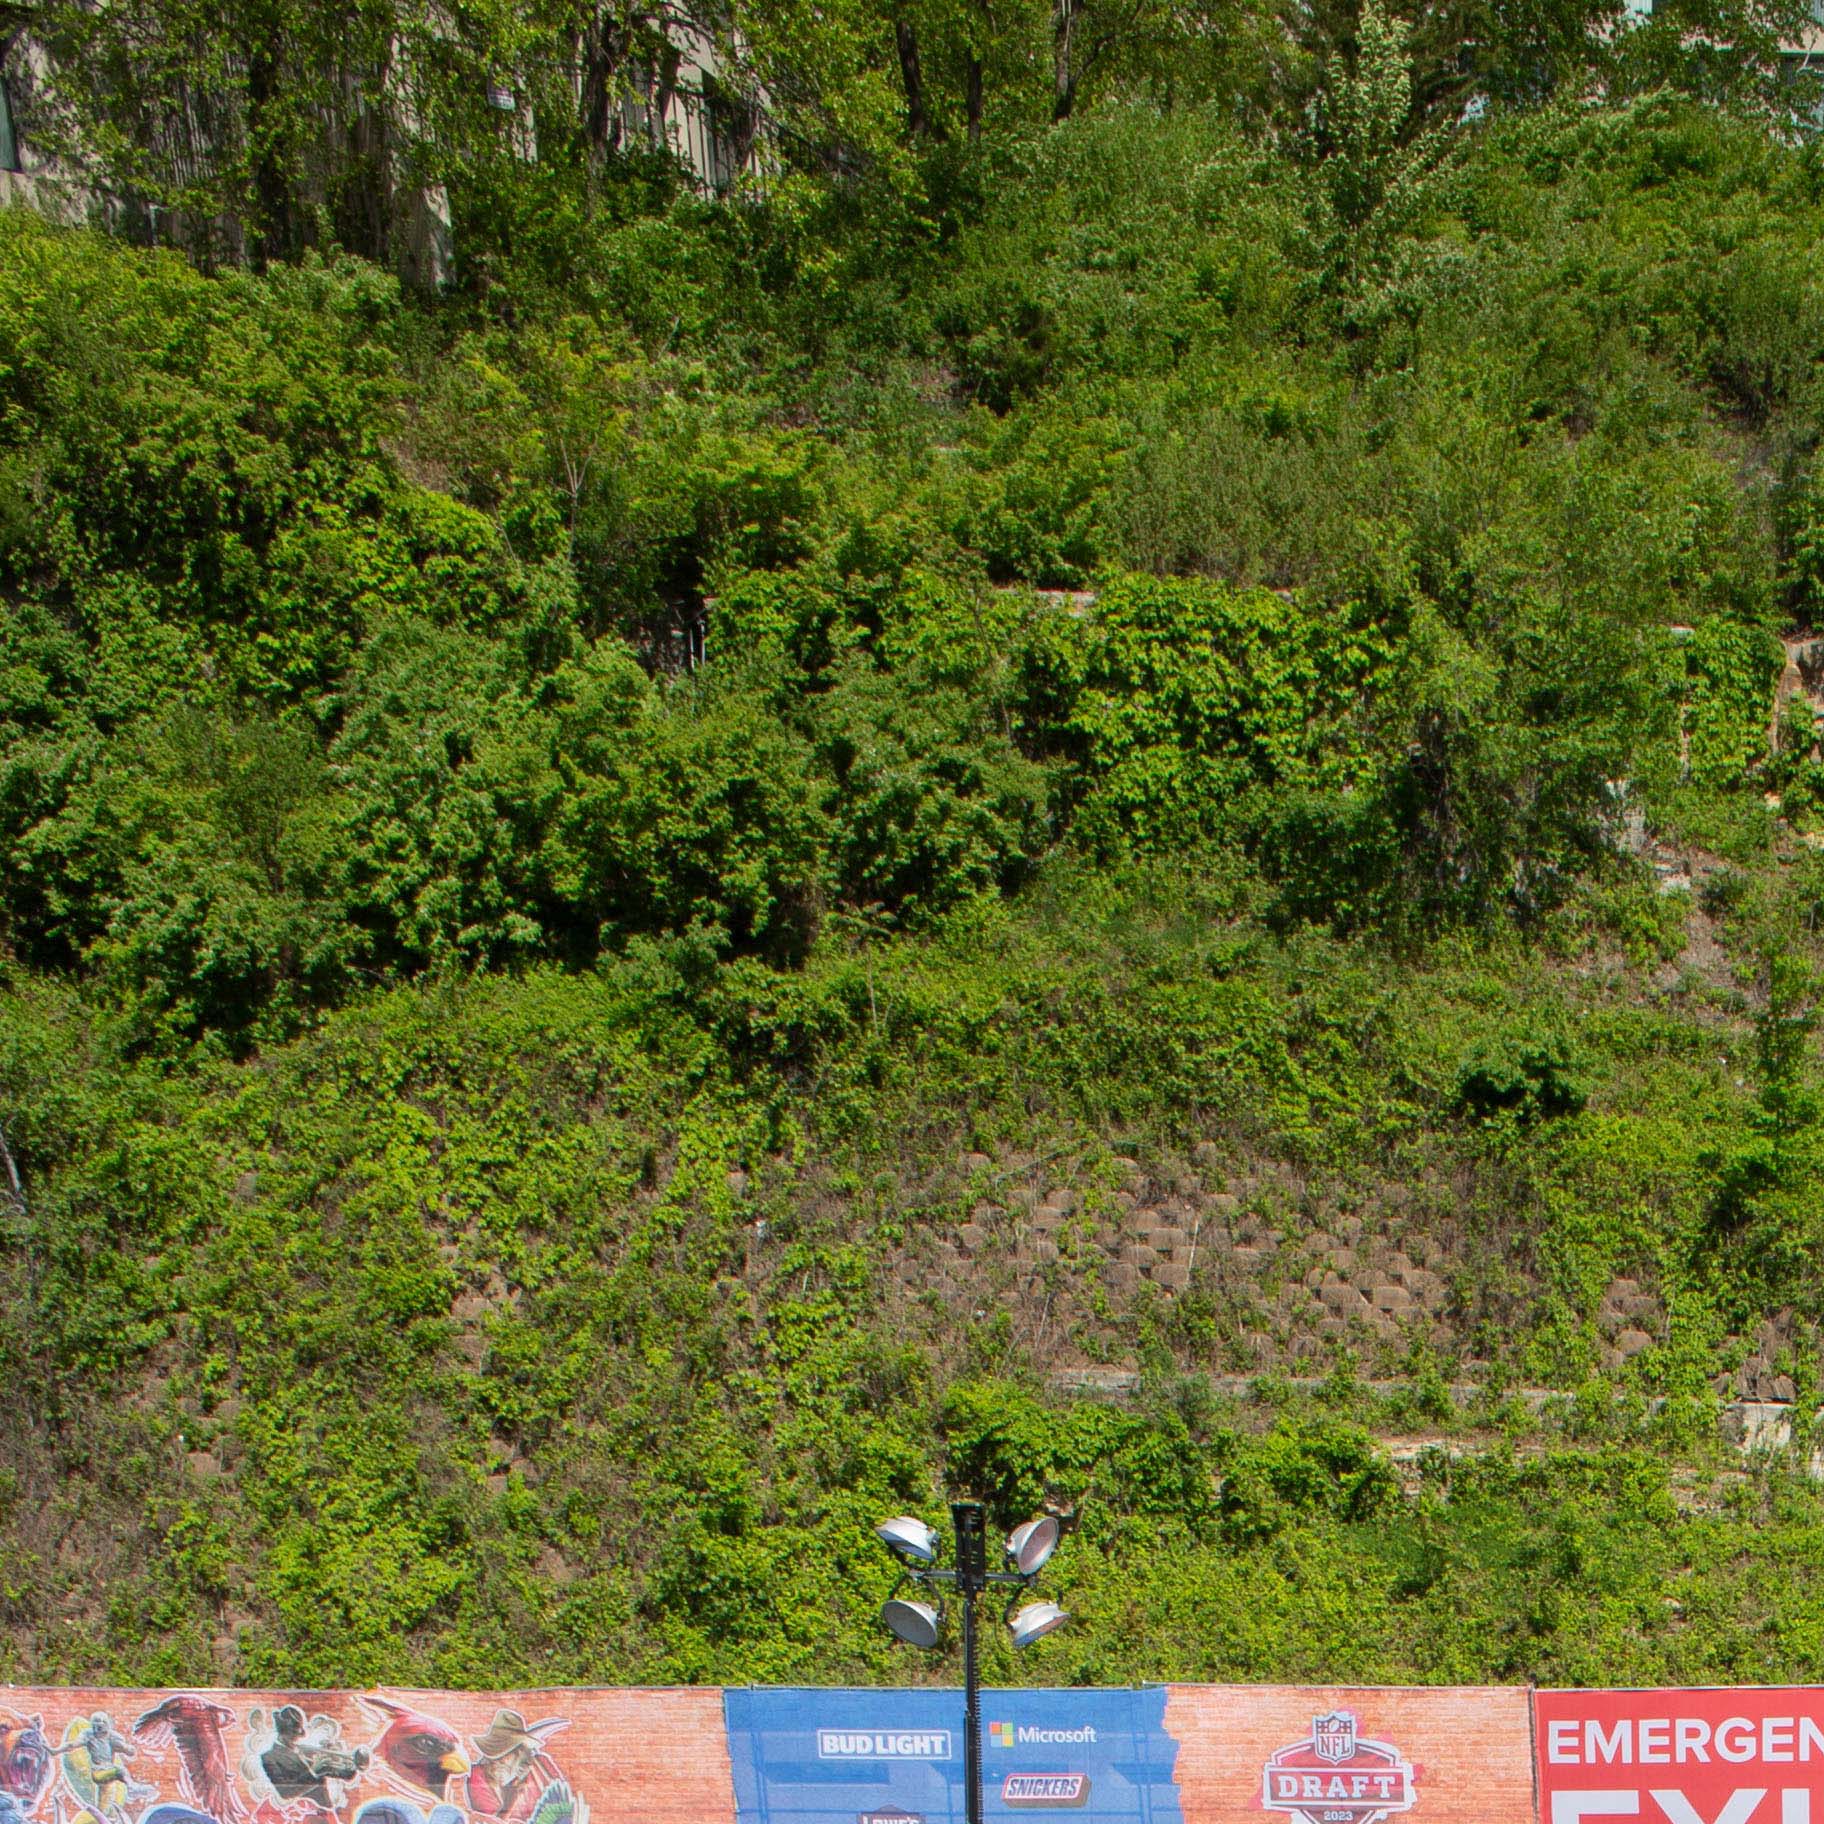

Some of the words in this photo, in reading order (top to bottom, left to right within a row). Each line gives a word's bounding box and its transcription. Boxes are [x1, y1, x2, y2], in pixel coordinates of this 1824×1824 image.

[1018, 1727, 1097, 1743] Microsoft
[822, 1735, 873, 1754] BUD
[876, 1735, 946, 1755] LIGHT
[1319, 1735, 1350, 1757] NFL
[1008, 1778, 1079, 1796] SNICKERS
[1278, 1776, 1395, 1798] DRAFT
[1323, 1811, 1353, 1821] 2023
